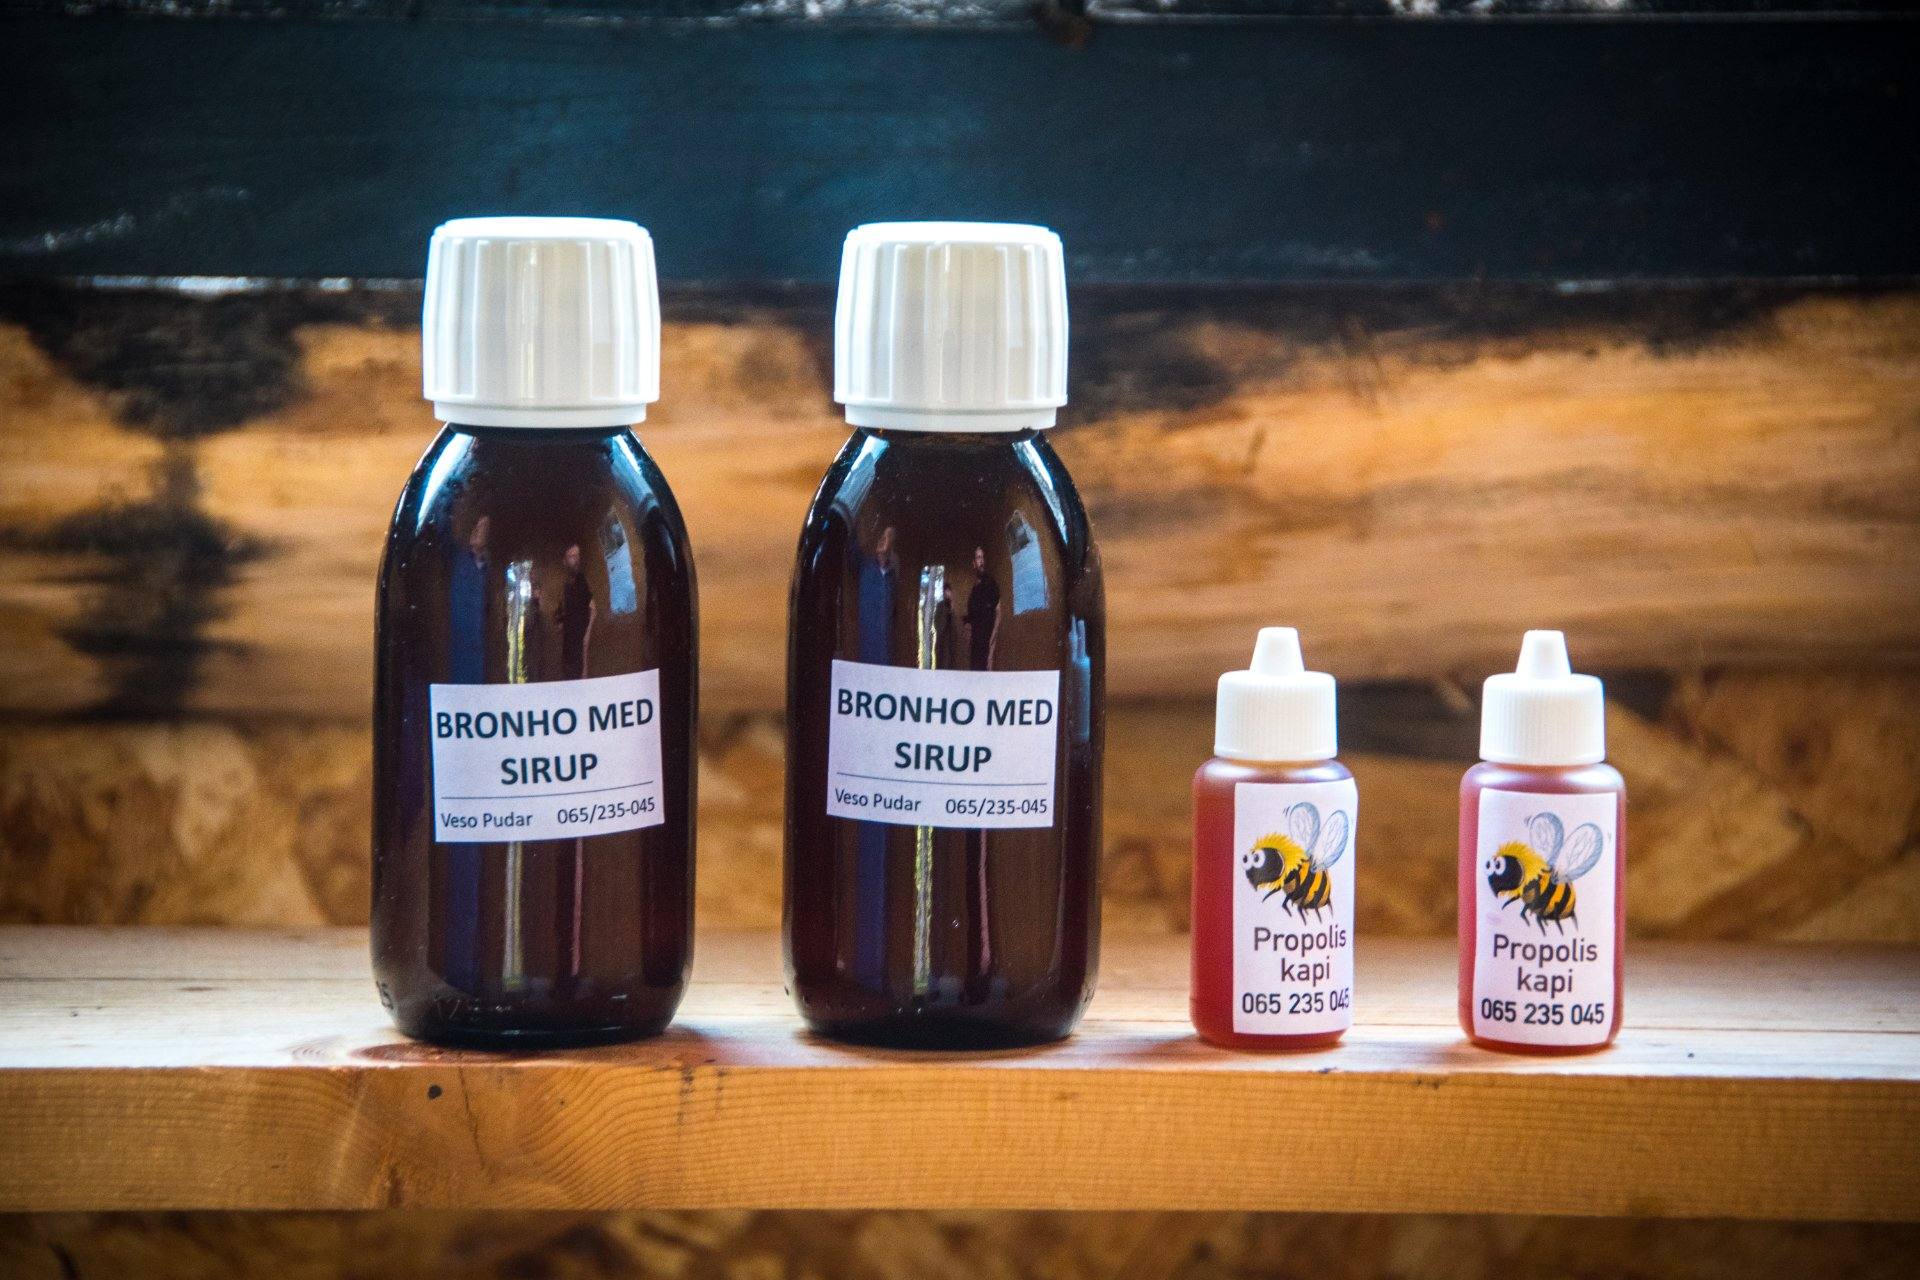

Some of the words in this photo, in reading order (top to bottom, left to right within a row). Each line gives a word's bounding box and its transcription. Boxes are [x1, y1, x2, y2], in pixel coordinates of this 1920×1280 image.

[436, 708, 577, 739] BRONHO
[589, 698, 653, 732] MED
[838, 688, 975, 725] BRONHO
[986, 699, 1053, 726] MED
[501, 753, 598, 785] SIRUP
[895, 742, 992, 772] SIRUP
[441, 812, 478, 828] Veso
[483, 811, 533, 828] Pudar
[557, 797, 655, 825] 065/235-045
[835, 788, 868, 807] Veso
[873, 793, 921, 812] Pudar
[945, 798, 1047, 817] 065/235-045
[1254, 925, 1346, 957] Propolis
[1493, 933, 1597, 968] Propolis
[1281, 956, 1330, 987] kapi
[1517, 966, 1573, 999] kapi
[1242, 992, 1281, 1014] 065
[1289, 992, 1324, 1014] 235
[1329, 987, 1349, 1011] 045
[1481, 998, 1516, 1023] 065
[1523, 1003, 1564, 1025] 235
[1571, 1003, 1604, 1025] 045
